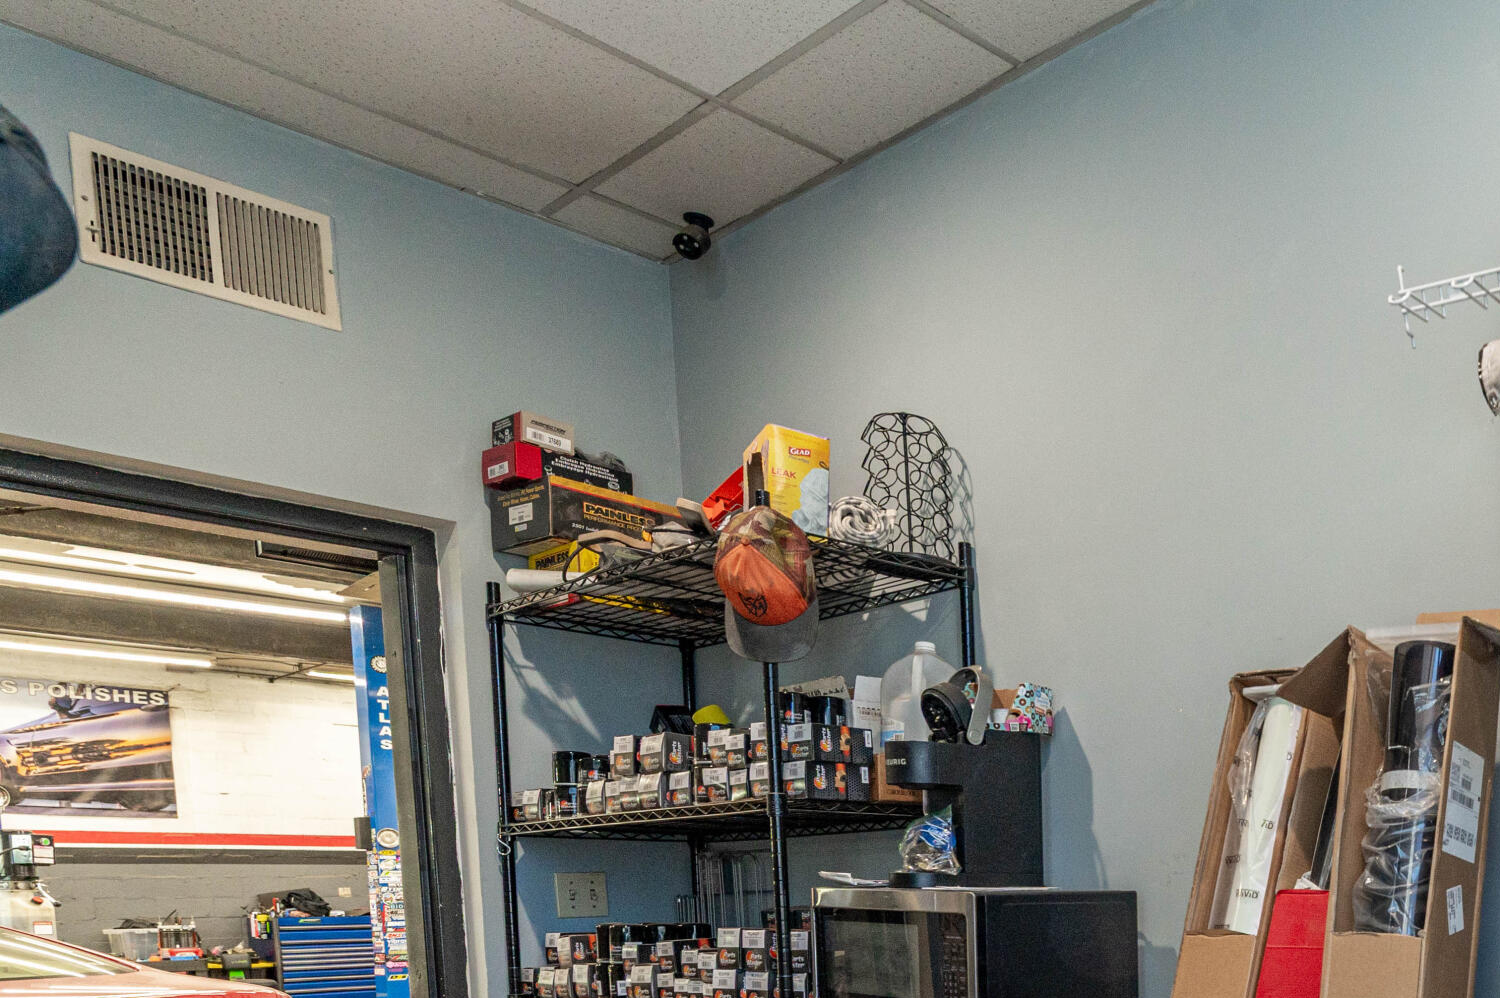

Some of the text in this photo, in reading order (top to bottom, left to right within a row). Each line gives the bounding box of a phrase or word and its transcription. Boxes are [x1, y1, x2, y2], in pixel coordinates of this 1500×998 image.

[790, 447, 811, 457] GLAD
[583, 502, 655, 525] PAINLESS
[28, 682, 166, 706] POLISHES
[376, 686, 393, 750] ATLAS
[885, 758, 907, 766] EURIG
